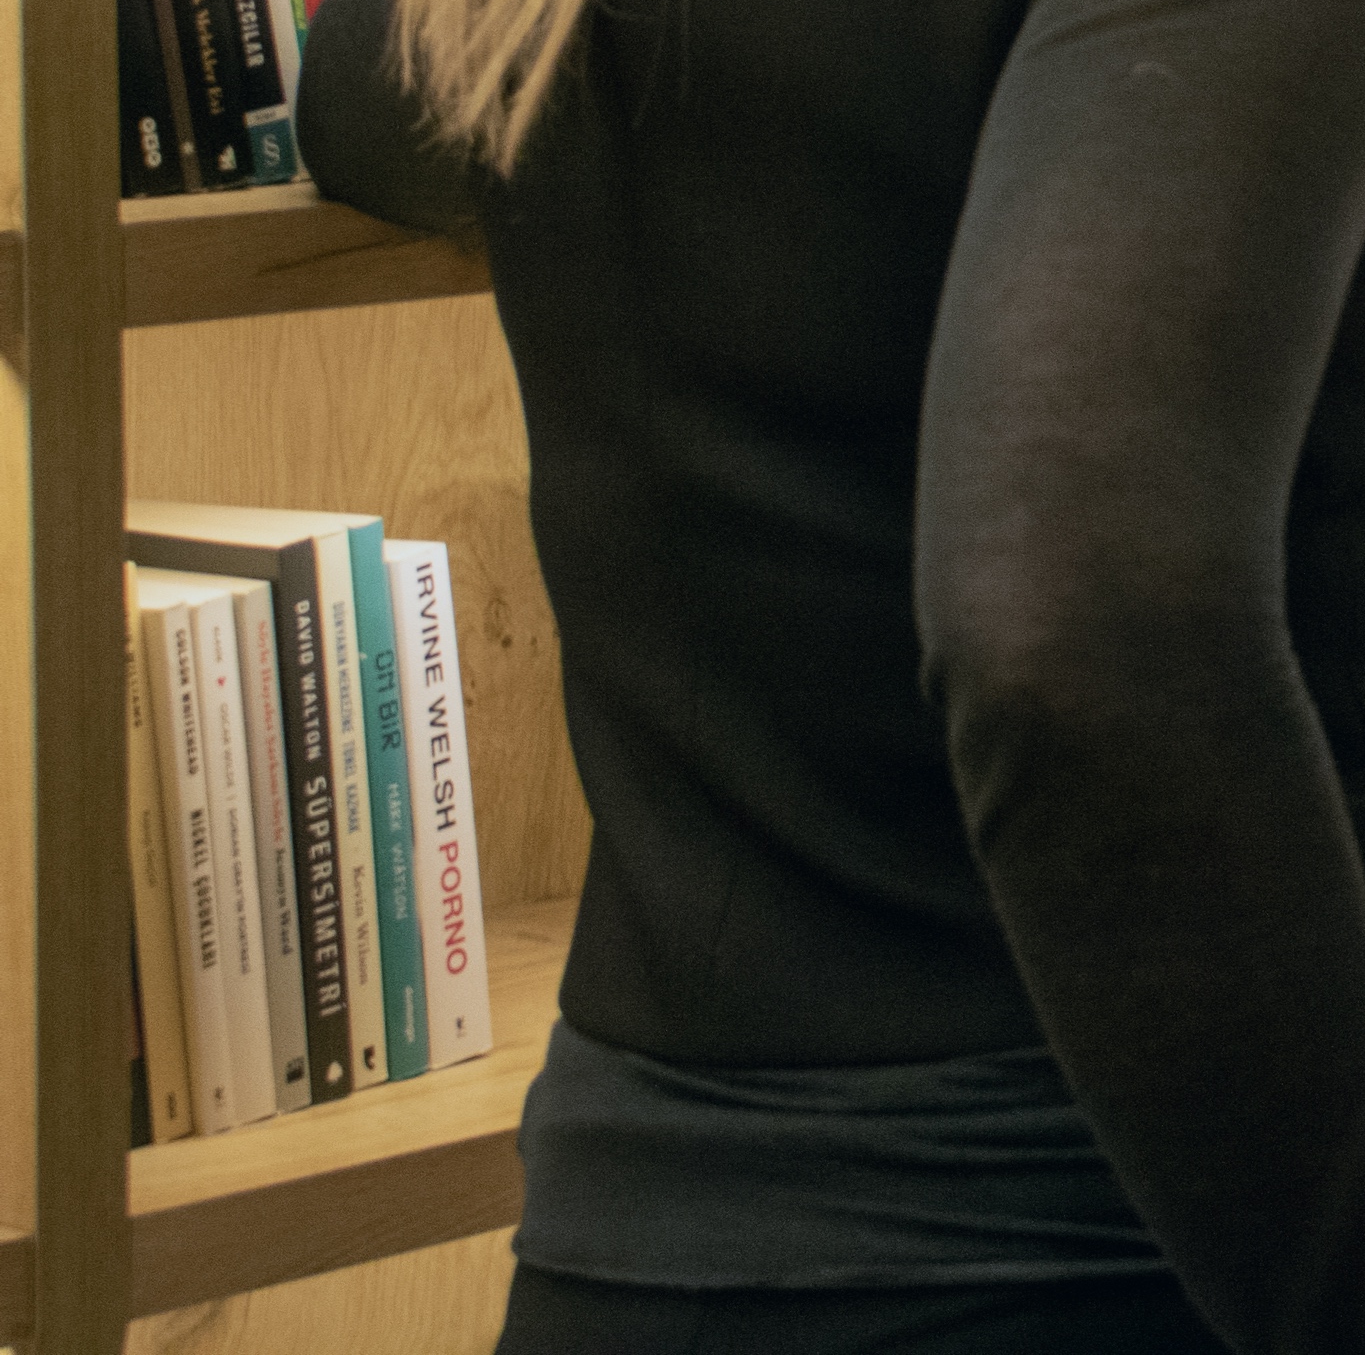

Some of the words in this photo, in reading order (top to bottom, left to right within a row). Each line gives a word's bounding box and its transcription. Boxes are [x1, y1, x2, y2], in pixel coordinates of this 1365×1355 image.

[294, 600, 315, 666] DAVID
[416, 561, 445, 688] IRVINE
[300, 671, 322, 762] WALTON
[427, 695, 457, 832] WELSH
[305, 775, 347, 1018] SÜPERSİMETRİ
[438, 839, 468, 977] PORNO
